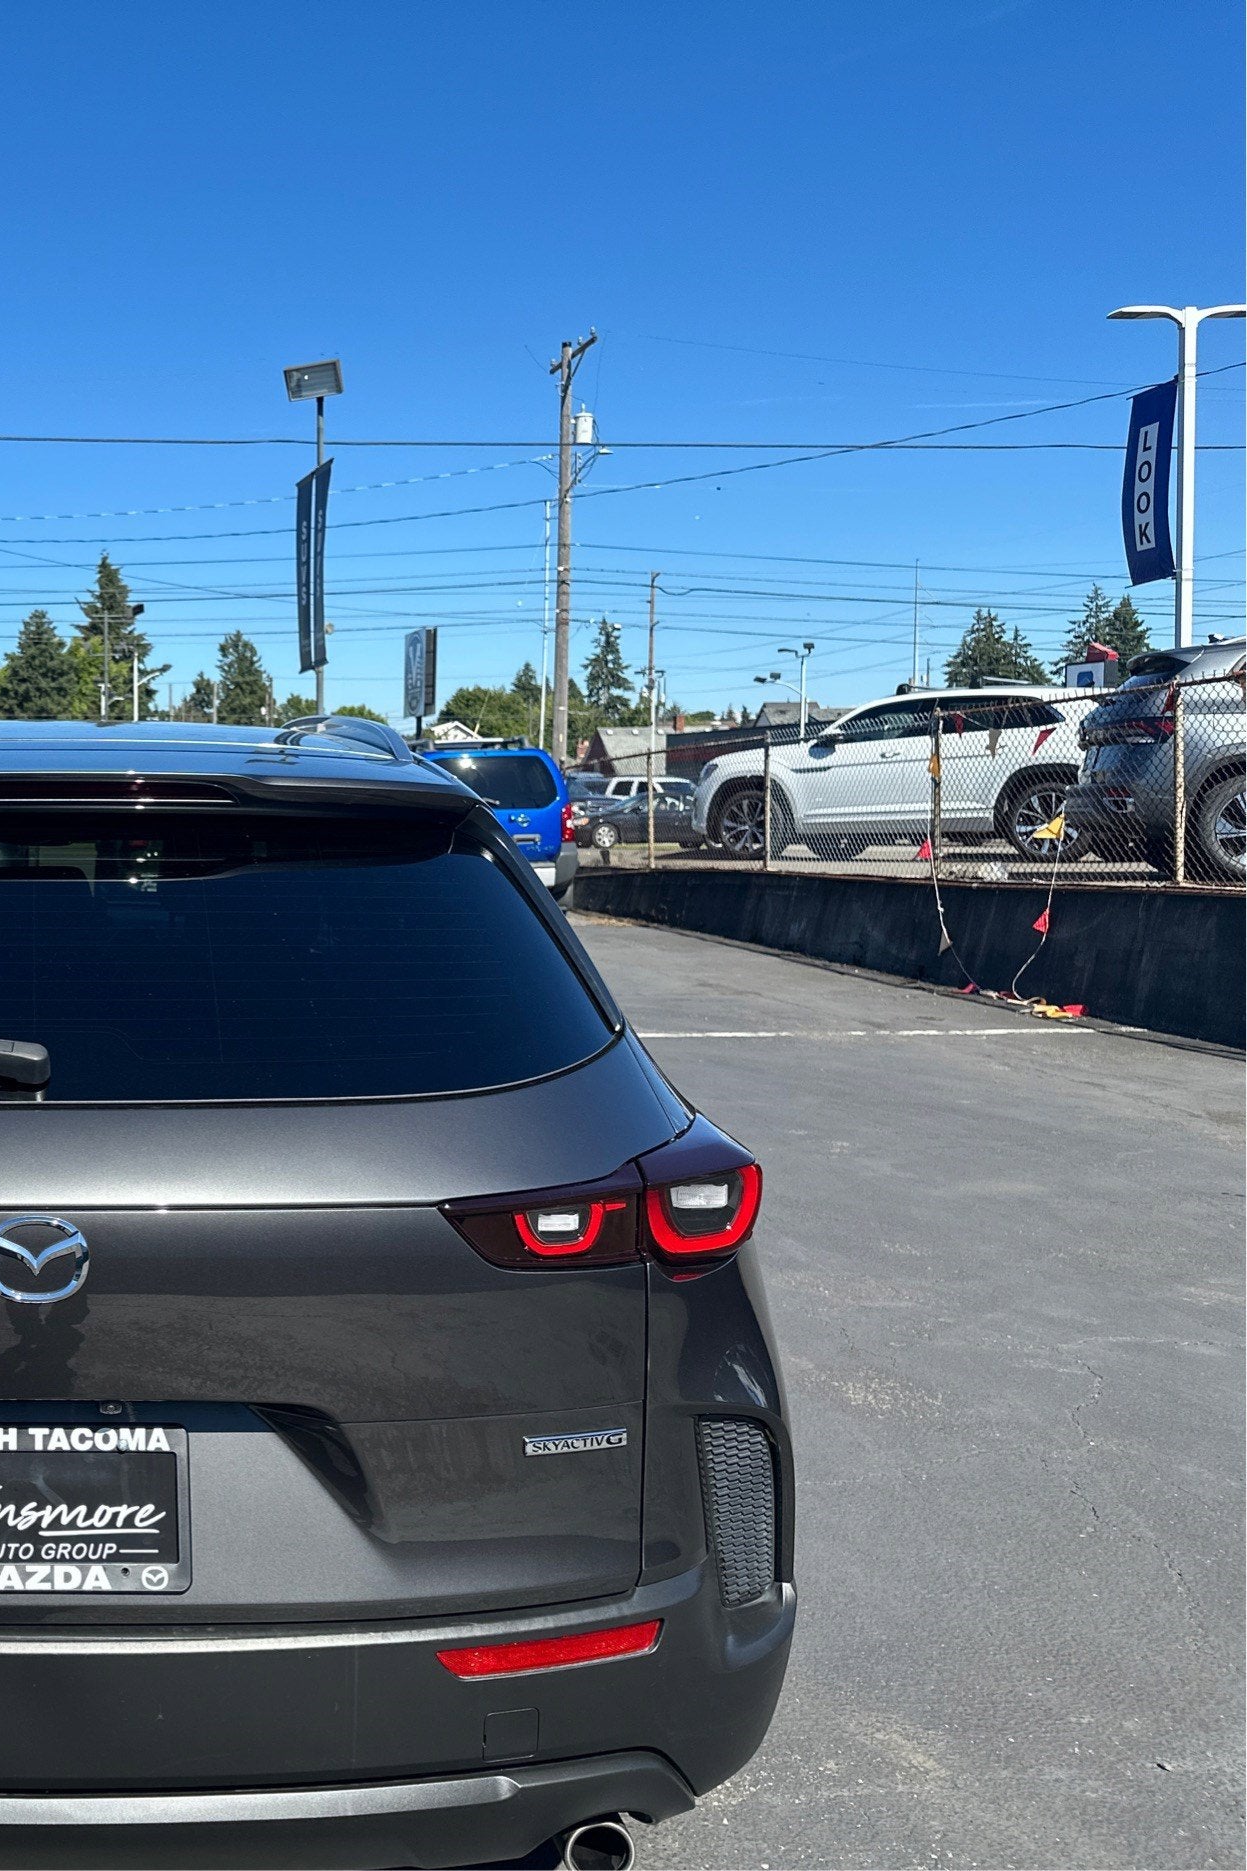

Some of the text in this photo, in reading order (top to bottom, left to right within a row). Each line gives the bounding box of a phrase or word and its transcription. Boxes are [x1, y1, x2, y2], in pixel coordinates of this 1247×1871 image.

[1136, 430, 1152, 546] LOOK
[28, 1427, 170, 1451] TACOMA
[40, 1543, 117, 1560] GROUP
